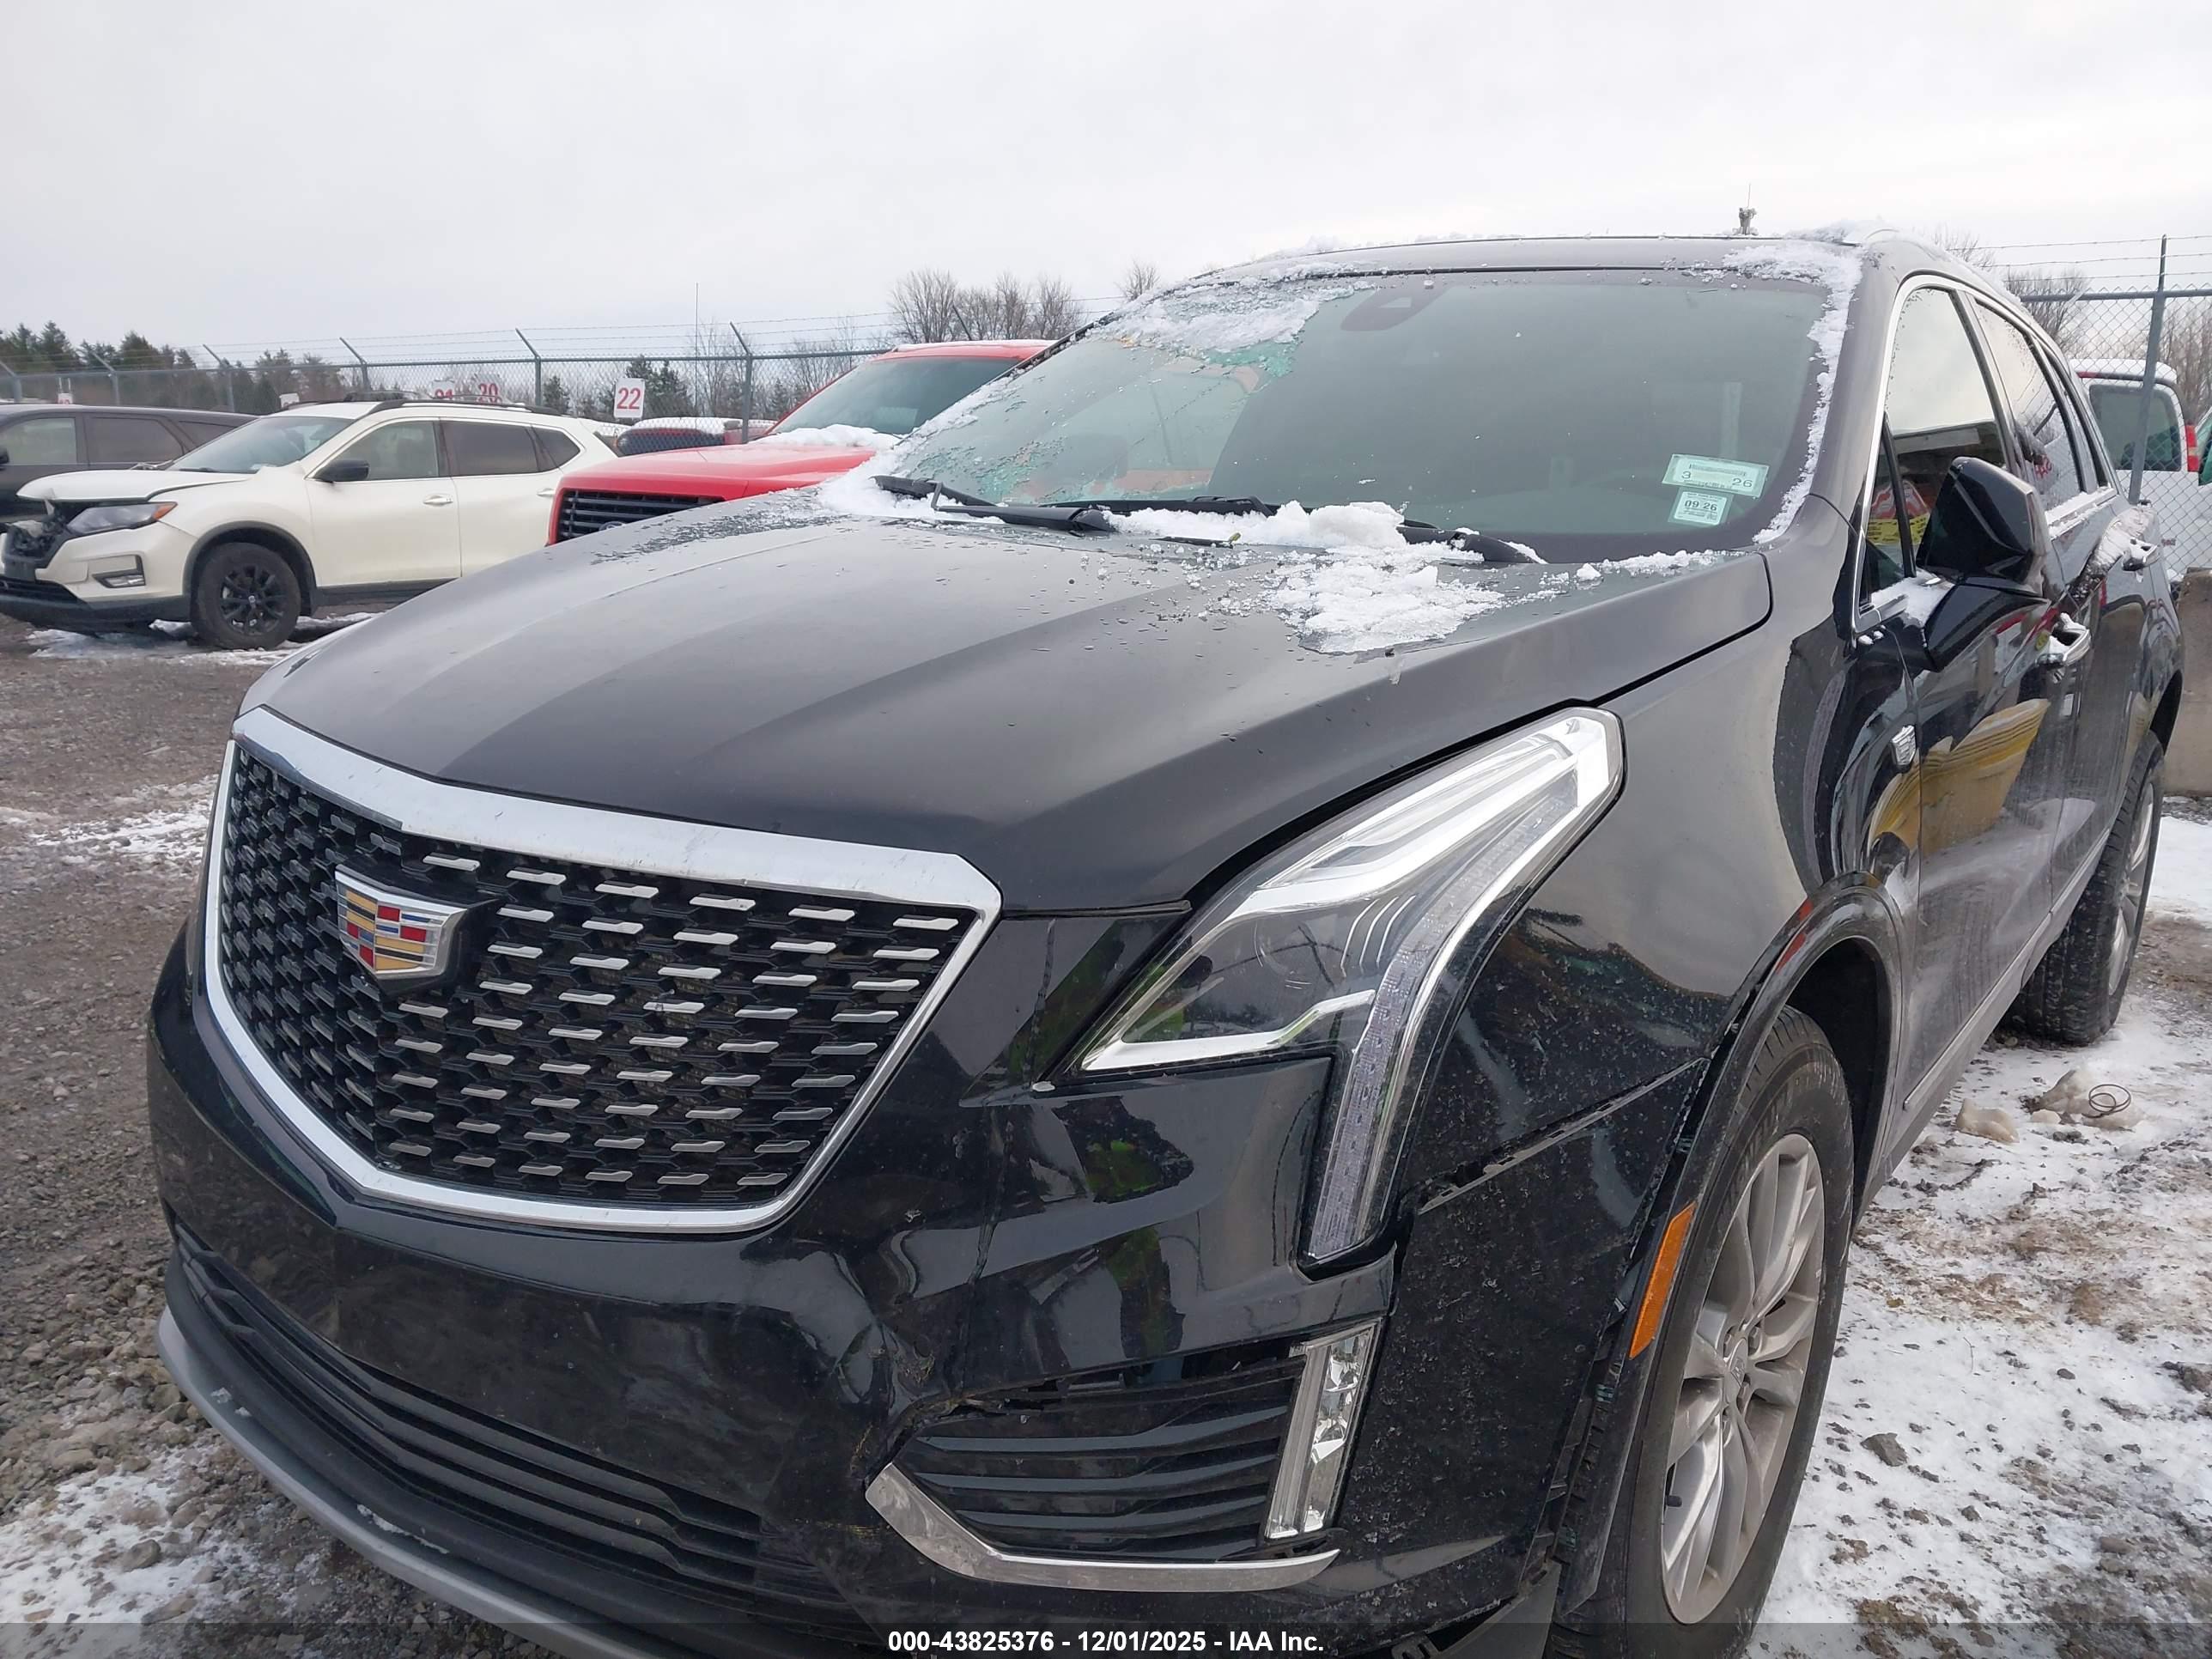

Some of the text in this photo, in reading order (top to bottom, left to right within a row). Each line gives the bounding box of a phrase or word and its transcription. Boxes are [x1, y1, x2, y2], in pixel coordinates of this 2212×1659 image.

[617, 387, 641, 410] 22
[1681, 471, 1692, 479] 3
[1731, 477, 1753, 488] 26
[1702, 501, 1717, 511] 26
